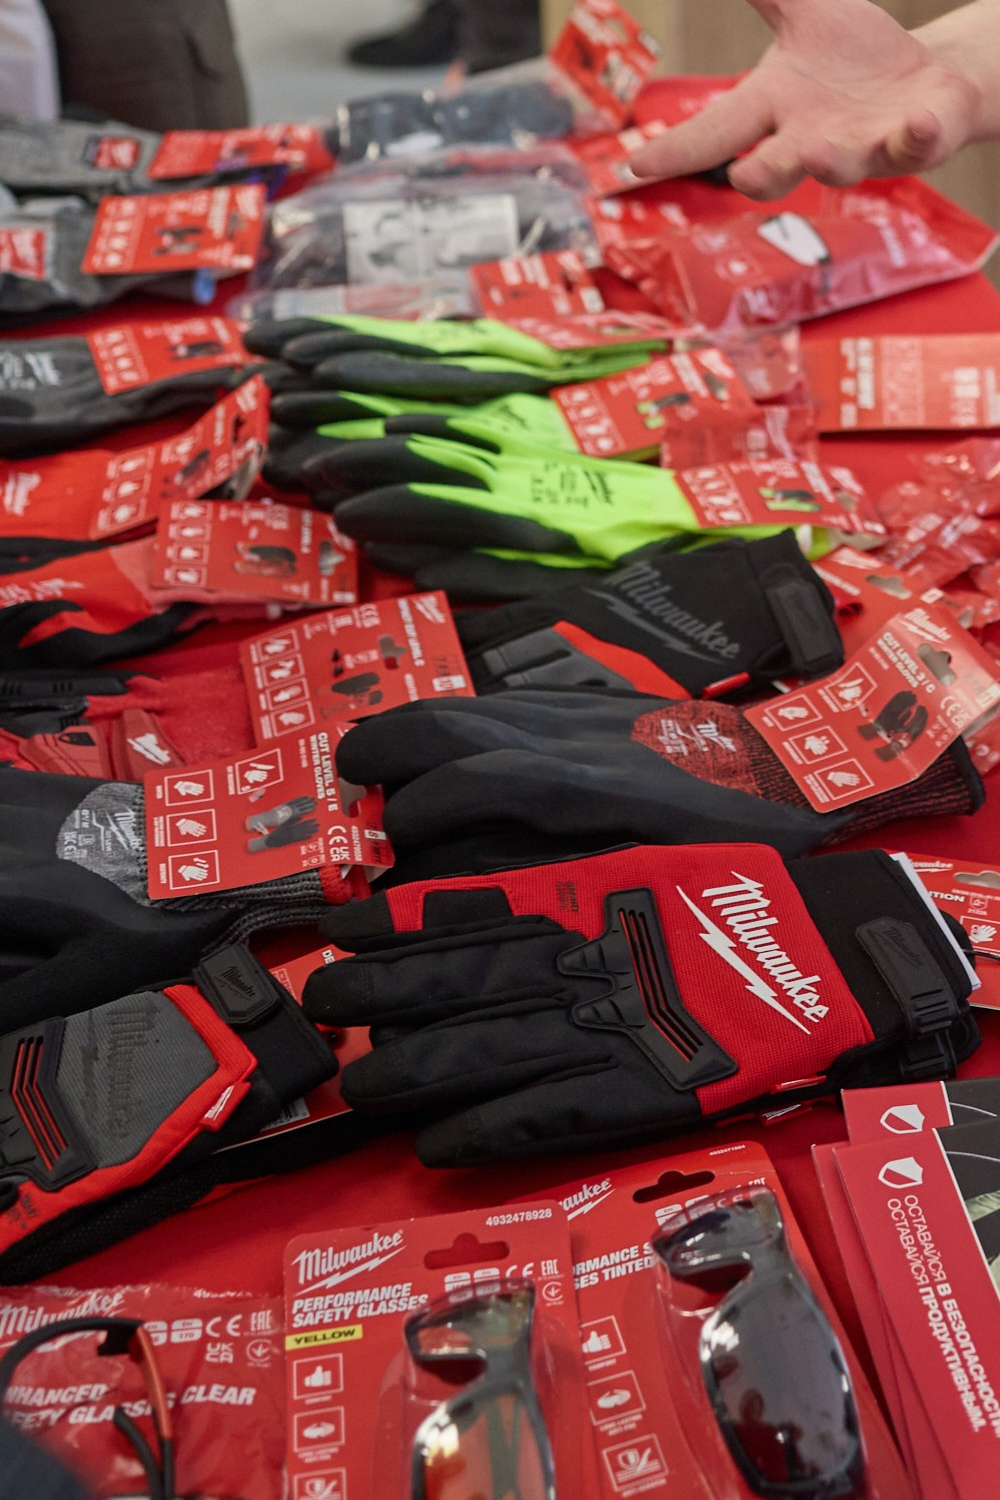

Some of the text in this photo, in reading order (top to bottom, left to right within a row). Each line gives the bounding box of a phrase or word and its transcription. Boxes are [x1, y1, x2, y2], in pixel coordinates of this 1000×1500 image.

[604, 560, 740, 659] Milwaukee
[882, 632, 901, 651] CUT
[896, 648, 920, 675] LEVEL
[318, 732, 330, 752] CUT
[309, 734, 326, 800] WINTER GLOVES
[321, 754, 336, 787] LEVEL
[702, 870, 829, 1023] Milwaukee
[485, 1209, 553, 1227] 4932478928
[291, 1231, 404, 1285] Milwaukee
[904, 1194, 948, 1283] ОСТАВАЙСЯ
[936, 1282, 952, 1297] В
[602, 1256, 655, 1282] TINTED
[292, 1282, 413, 1315] PERFORMANCE
[292, 1294, 429, 1329] SAFETY GLASSES
[887, 1198, 987, 1433] ОСТАВАЙСЯ ПРОДУКТИВНЫМ.
[293, 1327, 357, 1346] YELLOW
[181, 1385, 257, 1406] CLEAR
